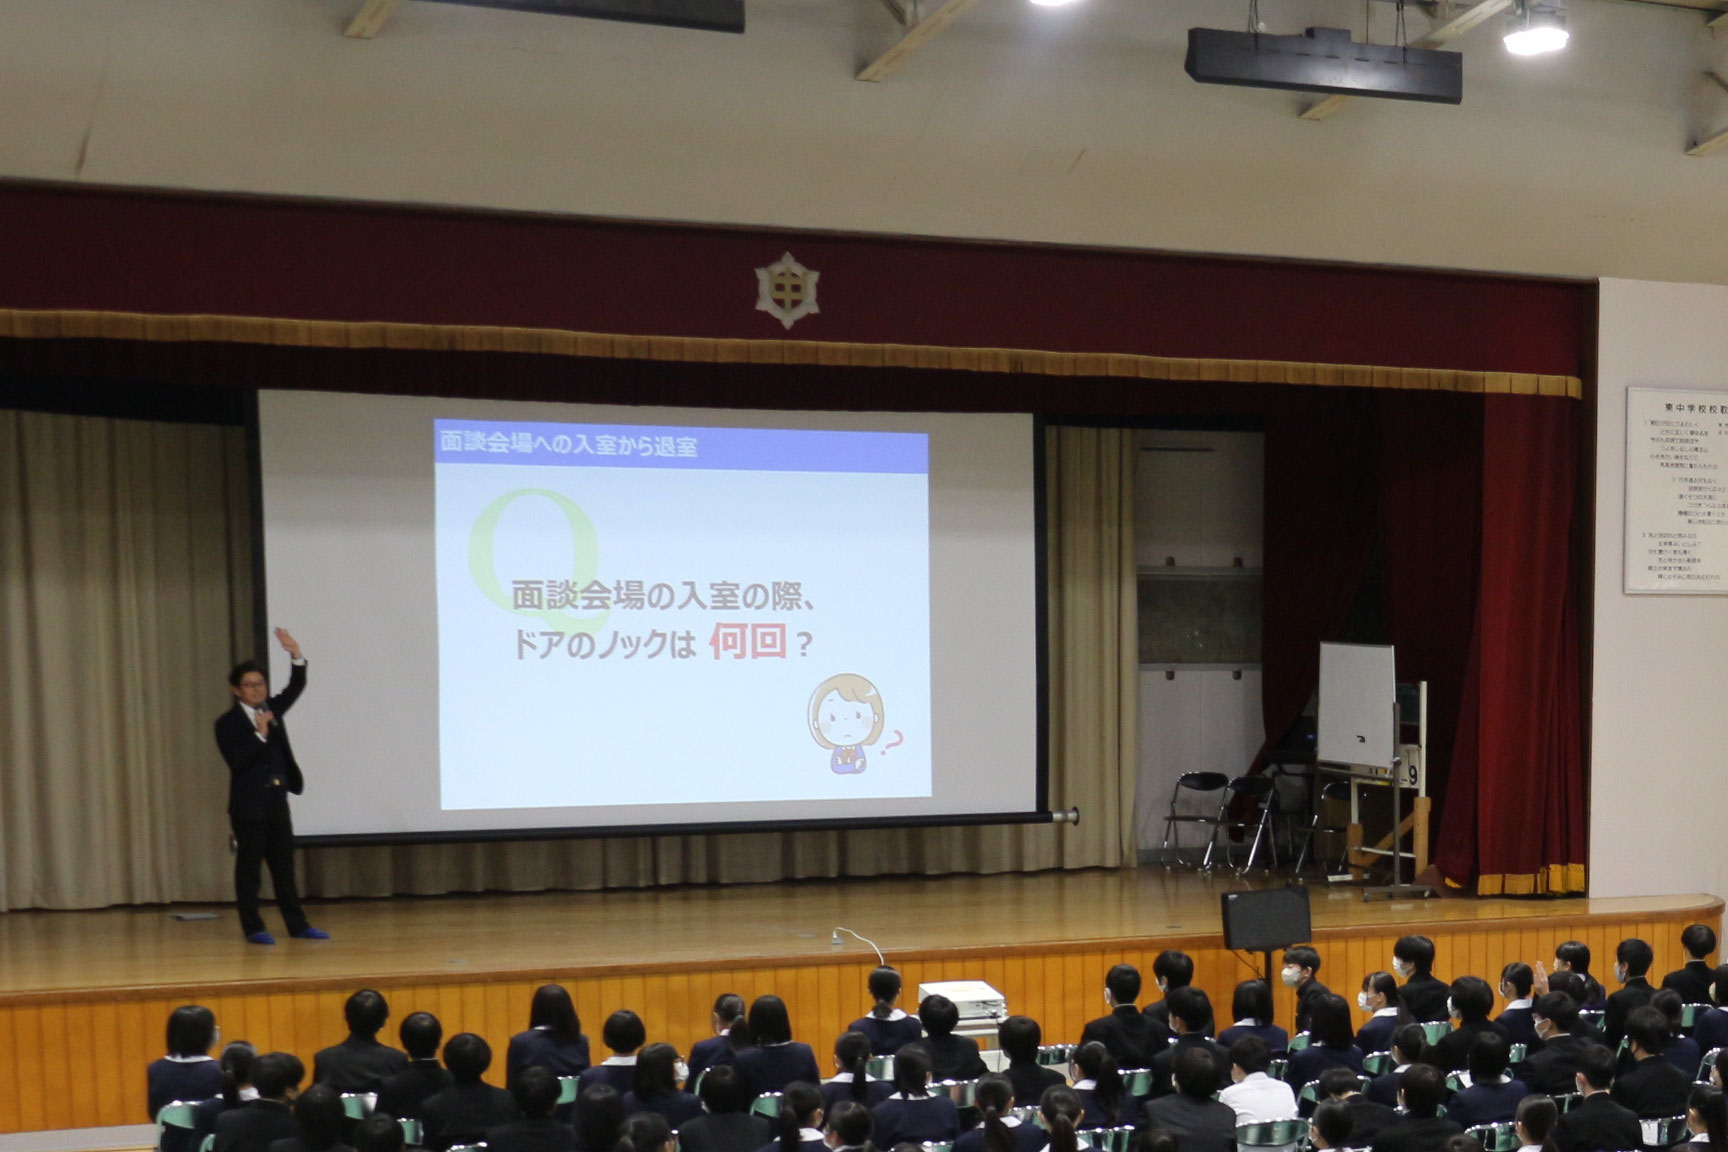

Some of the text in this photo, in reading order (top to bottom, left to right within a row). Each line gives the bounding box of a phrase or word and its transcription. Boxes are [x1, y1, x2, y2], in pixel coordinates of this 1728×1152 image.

[1665, 403, 1728, 414] 東中学校校歌
[440, 429, 698, 459] 面談会場への入室から退室
[467, 487, 611, 638] Q
[512, 579, 814, 611] 面談会場の入室の際、
[1409, 764, 1418, 786] 9
